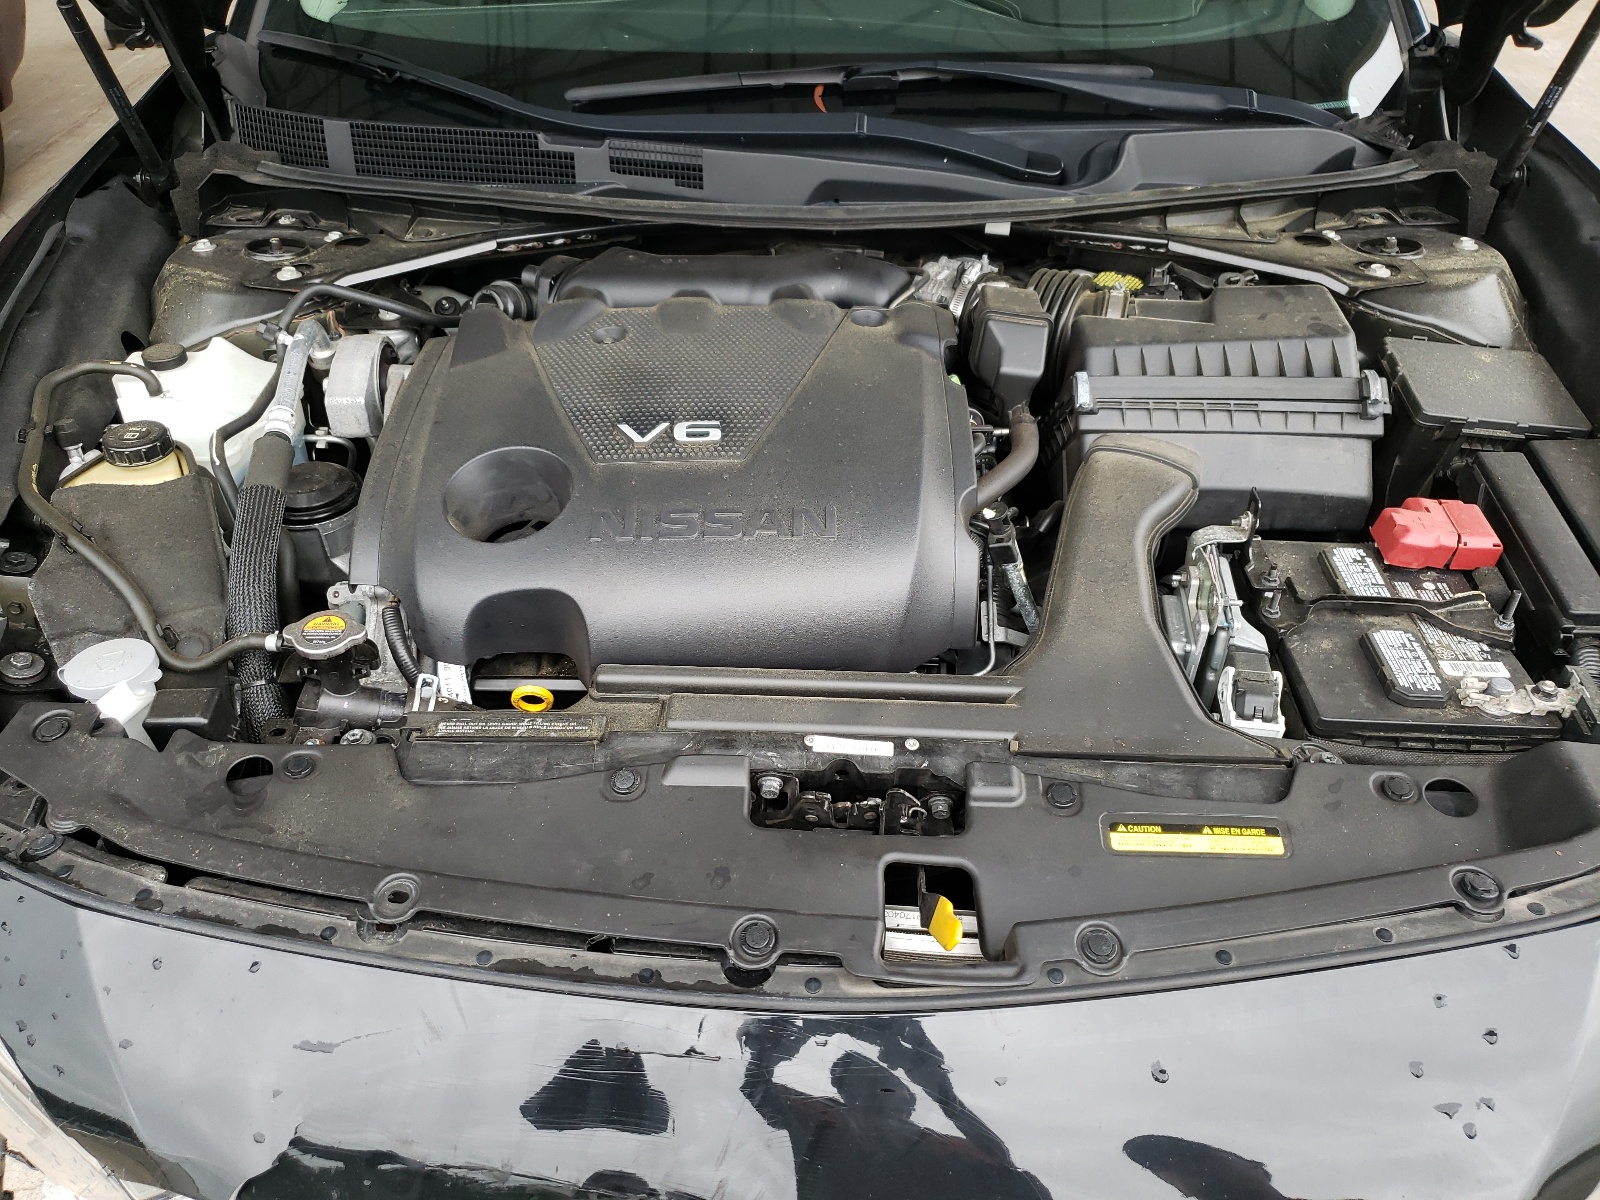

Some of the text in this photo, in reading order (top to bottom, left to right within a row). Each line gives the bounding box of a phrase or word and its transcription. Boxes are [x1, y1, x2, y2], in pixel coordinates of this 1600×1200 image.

[616, 420, 722, 446] V6
[588, 504, 838, 541] NISSAN
[1127, 825, 1162, 834] CAUTION
[1212, 826, 1266, 836] MISE EN GARDE
